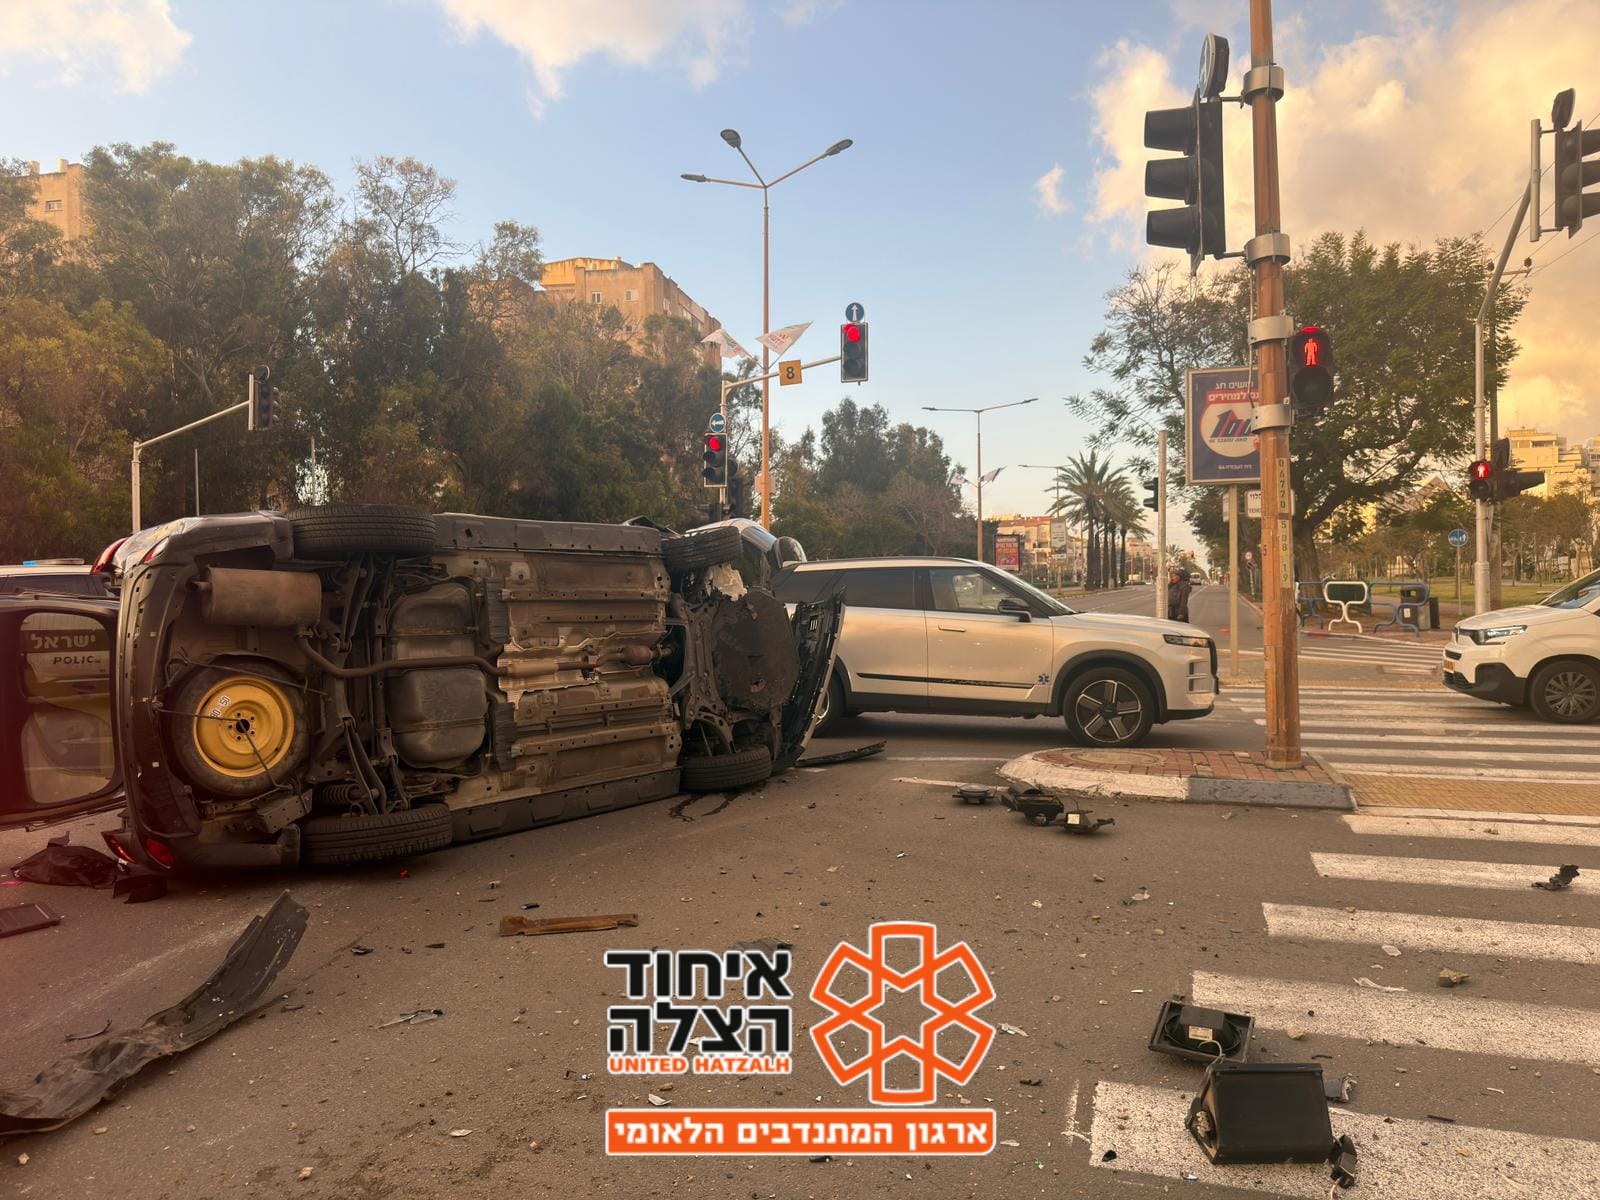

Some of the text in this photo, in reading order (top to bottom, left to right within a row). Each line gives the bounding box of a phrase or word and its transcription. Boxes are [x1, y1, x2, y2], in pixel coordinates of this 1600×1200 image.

[786, 366, 795, 379] 8
[1208, 391, 1247, 401] למחירים
[30, 633, 96, 650] ישראל
